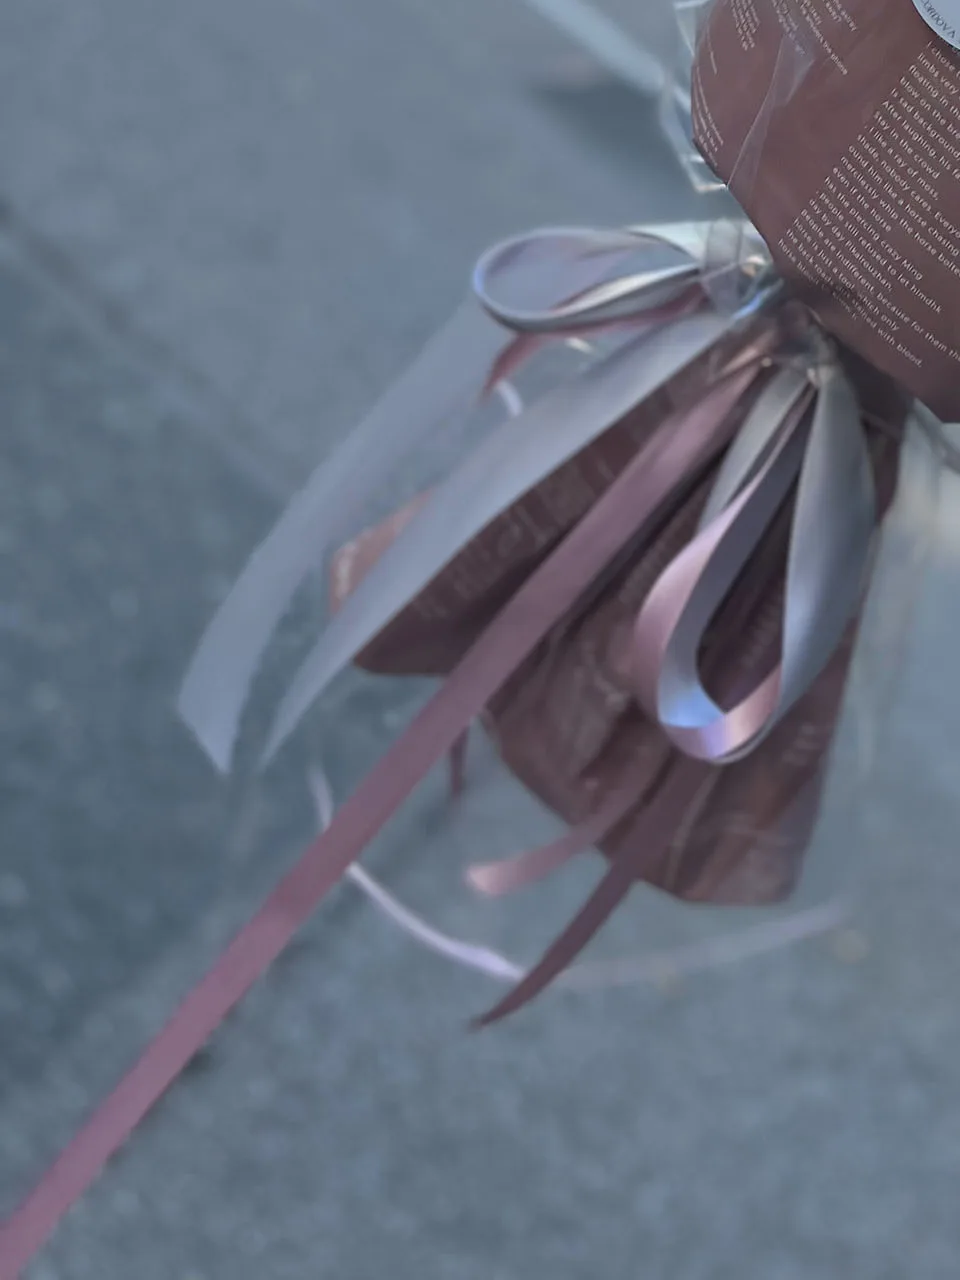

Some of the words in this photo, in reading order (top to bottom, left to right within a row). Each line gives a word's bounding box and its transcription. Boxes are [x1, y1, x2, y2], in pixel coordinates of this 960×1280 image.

[908, 64, 939, 98] floating
[917, 52, 939, 78] limbs
[940, 76, 959, 95] very
[931, 48, 956, 72] chose
[900, 76, 920, 99] blow
[919, 98, 932, 111] on
[932, 109, 947, 126] the
[873, 130, 887, 148] like
[893, 154, 908, 168] ray
[907, 167, 919, 178] of
[874, 111, 890, 131] Stay
[899, 138, 913, 154] the
[913, 154, 941, 179] crowd
[882, 100, 902, 121] After
[938, 155, 951, 170] his
[832, 167, 850, 188] even
[856, 194, 870, 210] the
[870, 208, 892, 232] horse
[840, 156, 879, 199] mercilessly
[879, 199, 899, 220] whip
[899, 218, 913, 234] the
[914, 232, 937, 255] horse
[848, 145, 869, 168] ound
[867, 165, 883, 185] him
[883, 182, 898, 199] like
[904, 203, 927, 227] horse
[927, 227, 960, 257] chasing
[880, 160, 911, 191] nobody
[809, 199, 822, 215] day
[821, 212, 832, 226] by
[831, 225, 846, 241] day
[824, 176, 837, 193] has
[836, 192, 850, 208] the
[848, 208, 880, 241] piercing
[880, 240, 902, 261] crazy
[901, 259, 923, 281] Ming
[786, 228, 798, 244] the
[798, 242, 814, 264] back
[877, 328, 895, 346] with
[793, 217, 812, 243] horse
[811, 241, 819, 251] is
[817, 249, 833, 267] just
[880, 314, 900, 331] only
[844, 221, 860, 237] still
[858, 236, 888, 266] refused
[887, 264, 897, 276] to
[897, 273, 910, 287] let
[823, 238, 836, 252] are
[876, 292, 910, 323] because
[910, 321, 924, 334] for
[924, 332, 947, 352] them
